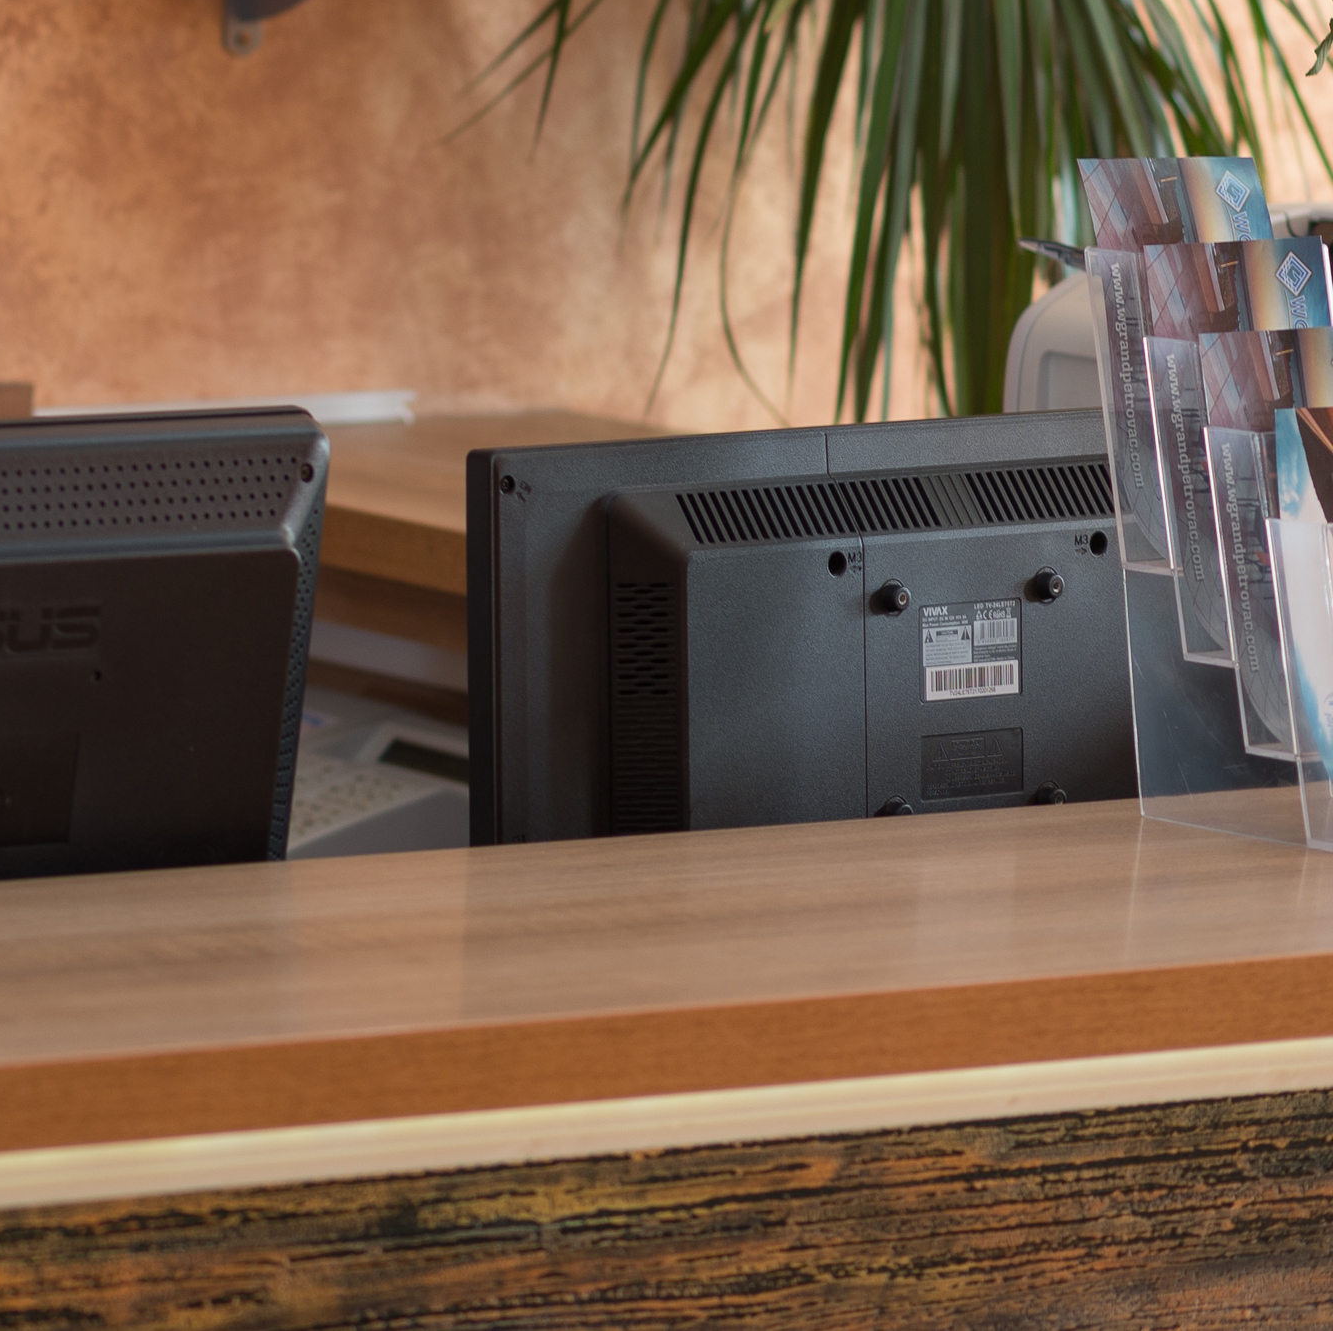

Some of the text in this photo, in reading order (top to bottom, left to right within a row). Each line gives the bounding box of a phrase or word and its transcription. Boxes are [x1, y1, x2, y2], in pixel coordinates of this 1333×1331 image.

[1110, 262, 1145, 489] www.wgrandpetrovac.com
[1165, 353, 1205, 582] www.wgrandpetrovac.com
[848, 551, 862, 563] M3
[1074, 534, 1089, 547] M3
[1221, 442, 1260, 673] www.wgrandpetrovac.com
[923, 606, 949, 617] VIVAX
